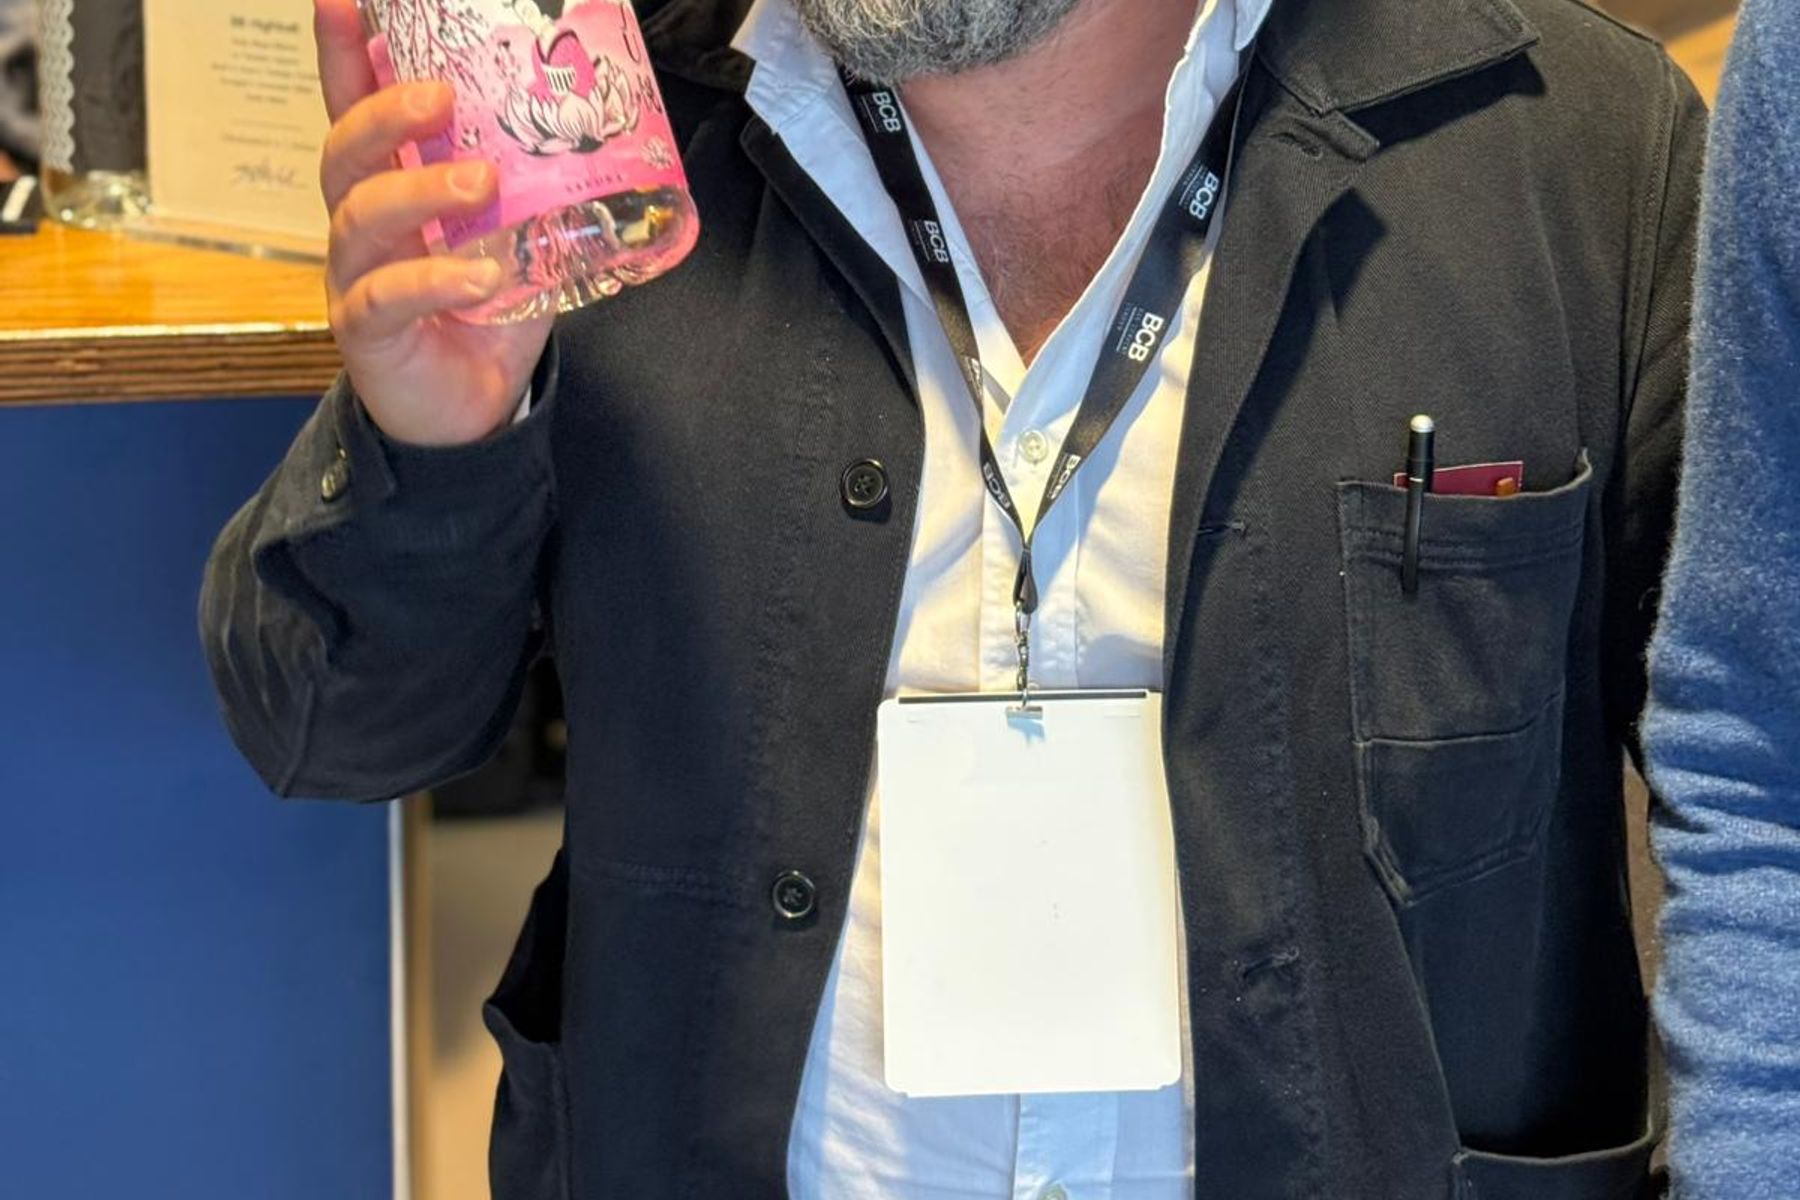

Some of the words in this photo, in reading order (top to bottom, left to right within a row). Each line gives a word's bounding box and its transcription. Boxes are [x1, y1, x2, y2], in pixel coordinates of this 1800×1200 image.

[872, 90, 902, 134] BCB
[1188, 170, 1220, 220] BCB
[923, 219, 950, 264] BCB
[1127, 311, 1165, 362] BCB
